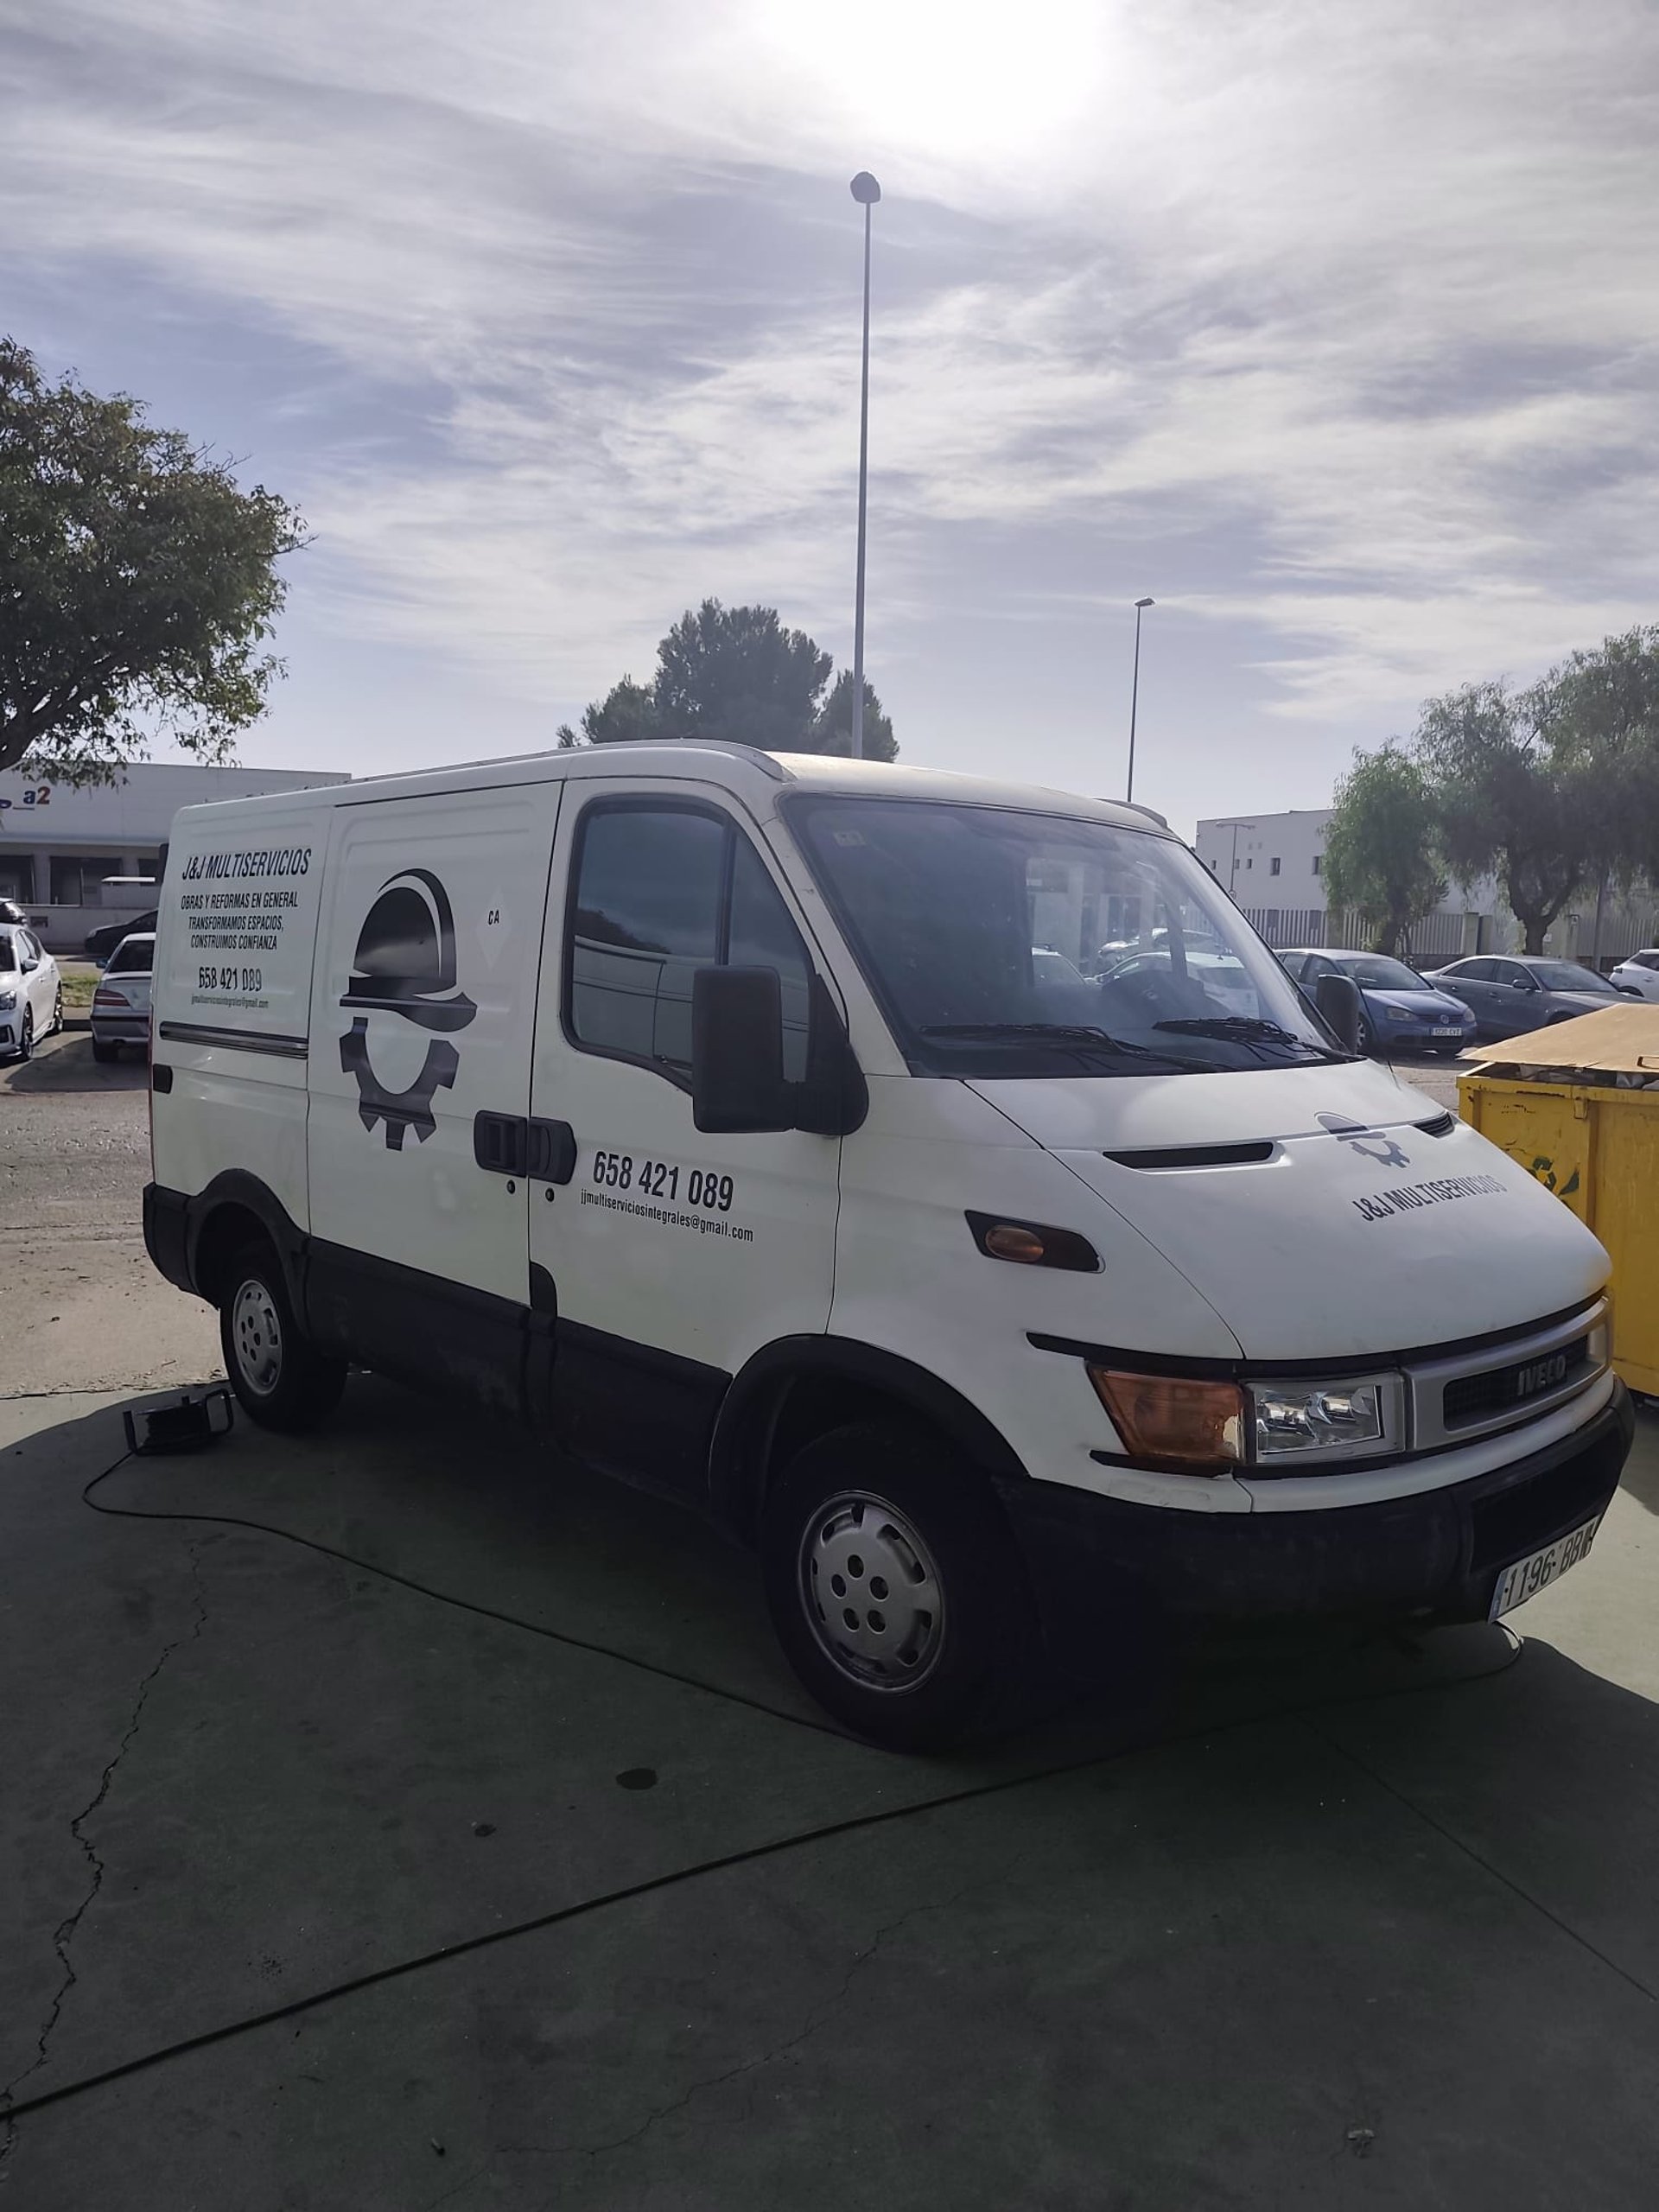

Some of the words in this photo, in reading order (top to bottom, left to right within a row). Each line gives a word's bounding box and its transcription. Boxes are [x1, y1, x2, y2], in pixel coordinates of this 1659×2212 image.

[181, 855, 207, 880] J&J
[205, 849, 312, 880] MULTISERVICIOS
[181, 894, 205, 910] OBRAS
[205, 894, 211, 908] Y
[211, 893, 250, 908] REFORMAS
[251, 893, 261, 908] EN
[263, 891, 298, 908] GENERAL
[188, 916, 246, 931] TRANSFORMAMOS
[488, 910, 499, 925] CA
[190, 935, 238, 950] CONSTRUIMOS
[238, 935, 277, 950] CONFIANZA
[199, 967, 217, 989] 658
[220, 967, 238, 990] 421
[242, 968, 262, 992] 089
[593, 1151, 633, 1189] 658
[638, 1160, 679, 1200] 421
[688, 1170, 734, 1211] 089
[1351, 1194, 1395, 1222] J&J
[1383, 1174, 1507, 1211] MULTISERVICIOS
[581, 1189, 753, 1242] jjmultiserviciosintegrales@gmail.com
[1517, 1355, 1566, 1396] IVECO
